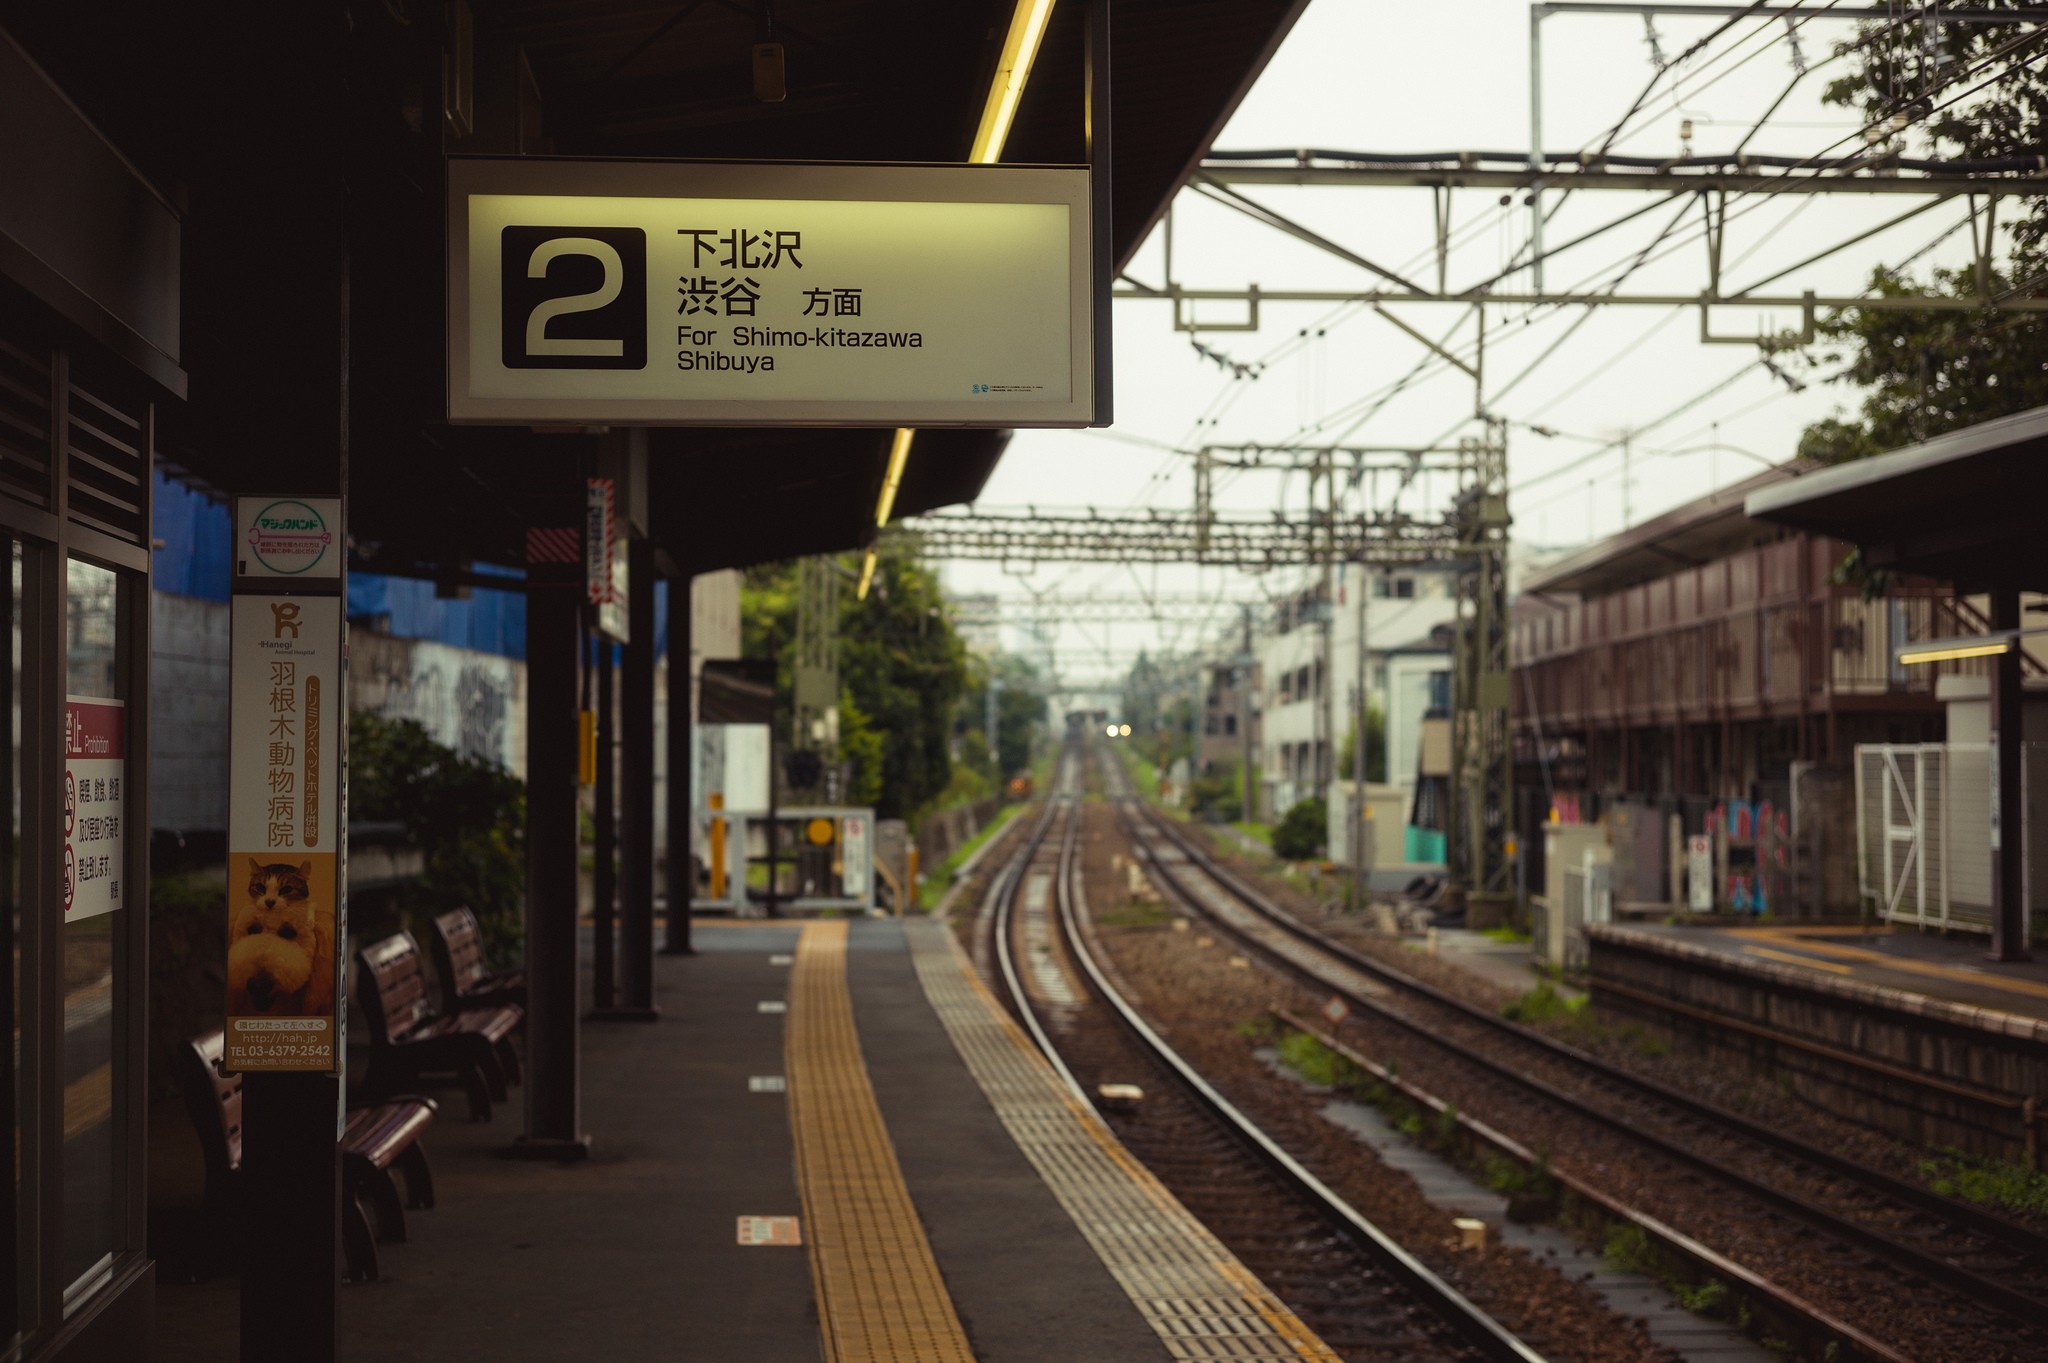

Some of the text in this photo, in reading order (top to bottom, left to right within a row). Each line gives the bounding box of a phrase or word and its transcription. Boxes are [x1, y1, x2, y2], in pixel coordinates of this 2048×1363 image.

[677, 228, 803, 270] 下北沢
[526, 237, 624, 357] 2
[677, 276, 863, 318] 渋谷 方面
[678, 326, 923, 349] For Shimo-kitazawa
[677, 351, 775, 373] Shibuya
[261, 519, 318, 530] マジックハンド
[261, 641, 292, 650] Hanegi
[85, 734, 110, 754] Prohibition
[268, 661, 296, 848] 羽根木動物病院
[239, 1021, 325, 1031] 環七わたって左へすぐ
[243, 1033, 318, 1044] http://hah.jp
[231, 1045, 331, 1057] TEL 03-6379-2542
